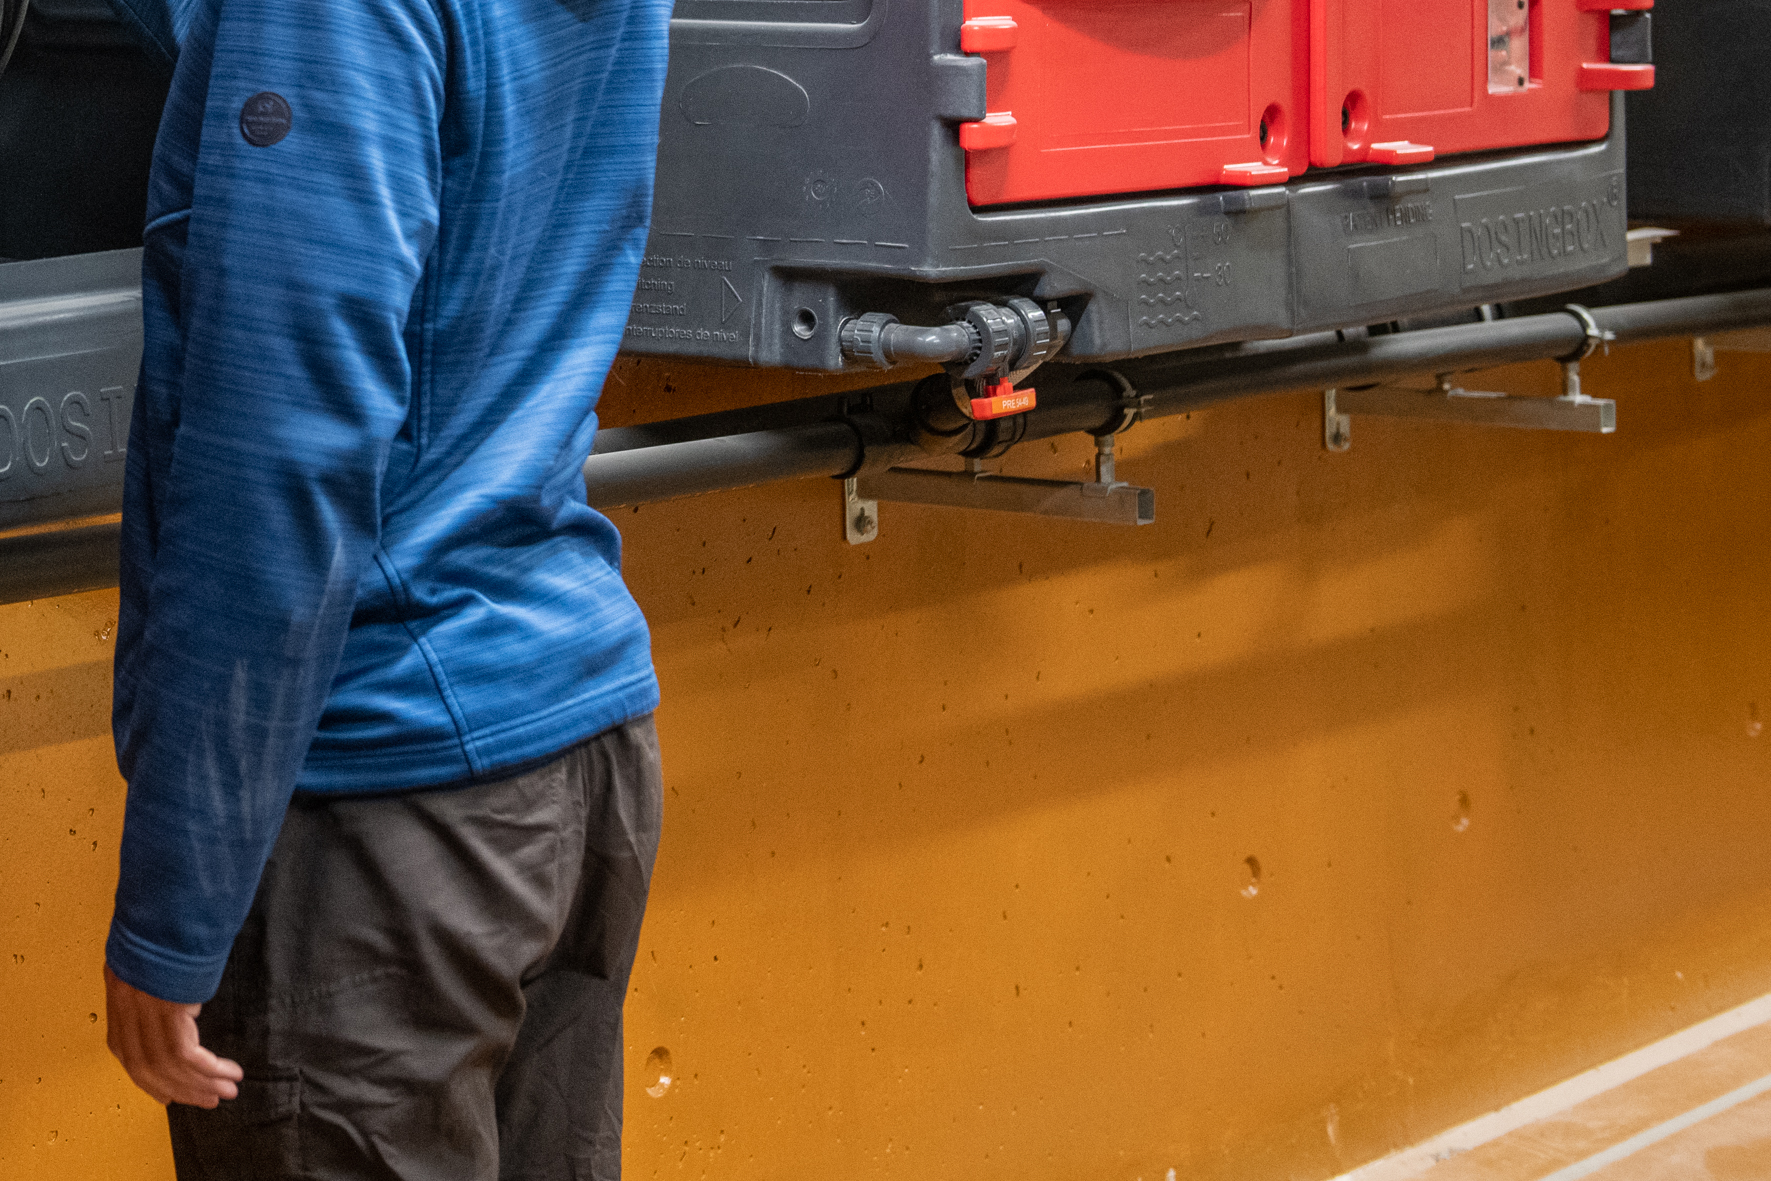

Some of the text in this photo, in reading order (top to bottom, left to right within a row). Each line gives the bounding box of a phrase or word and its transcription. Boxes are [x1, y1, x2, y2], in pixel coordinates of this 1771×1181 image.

[677, 255, 691, 268] de
[694, 257, 733, 271] niveau
[695, 327, 710, 340] de
[1002, 399, 1016, 410] PRE
